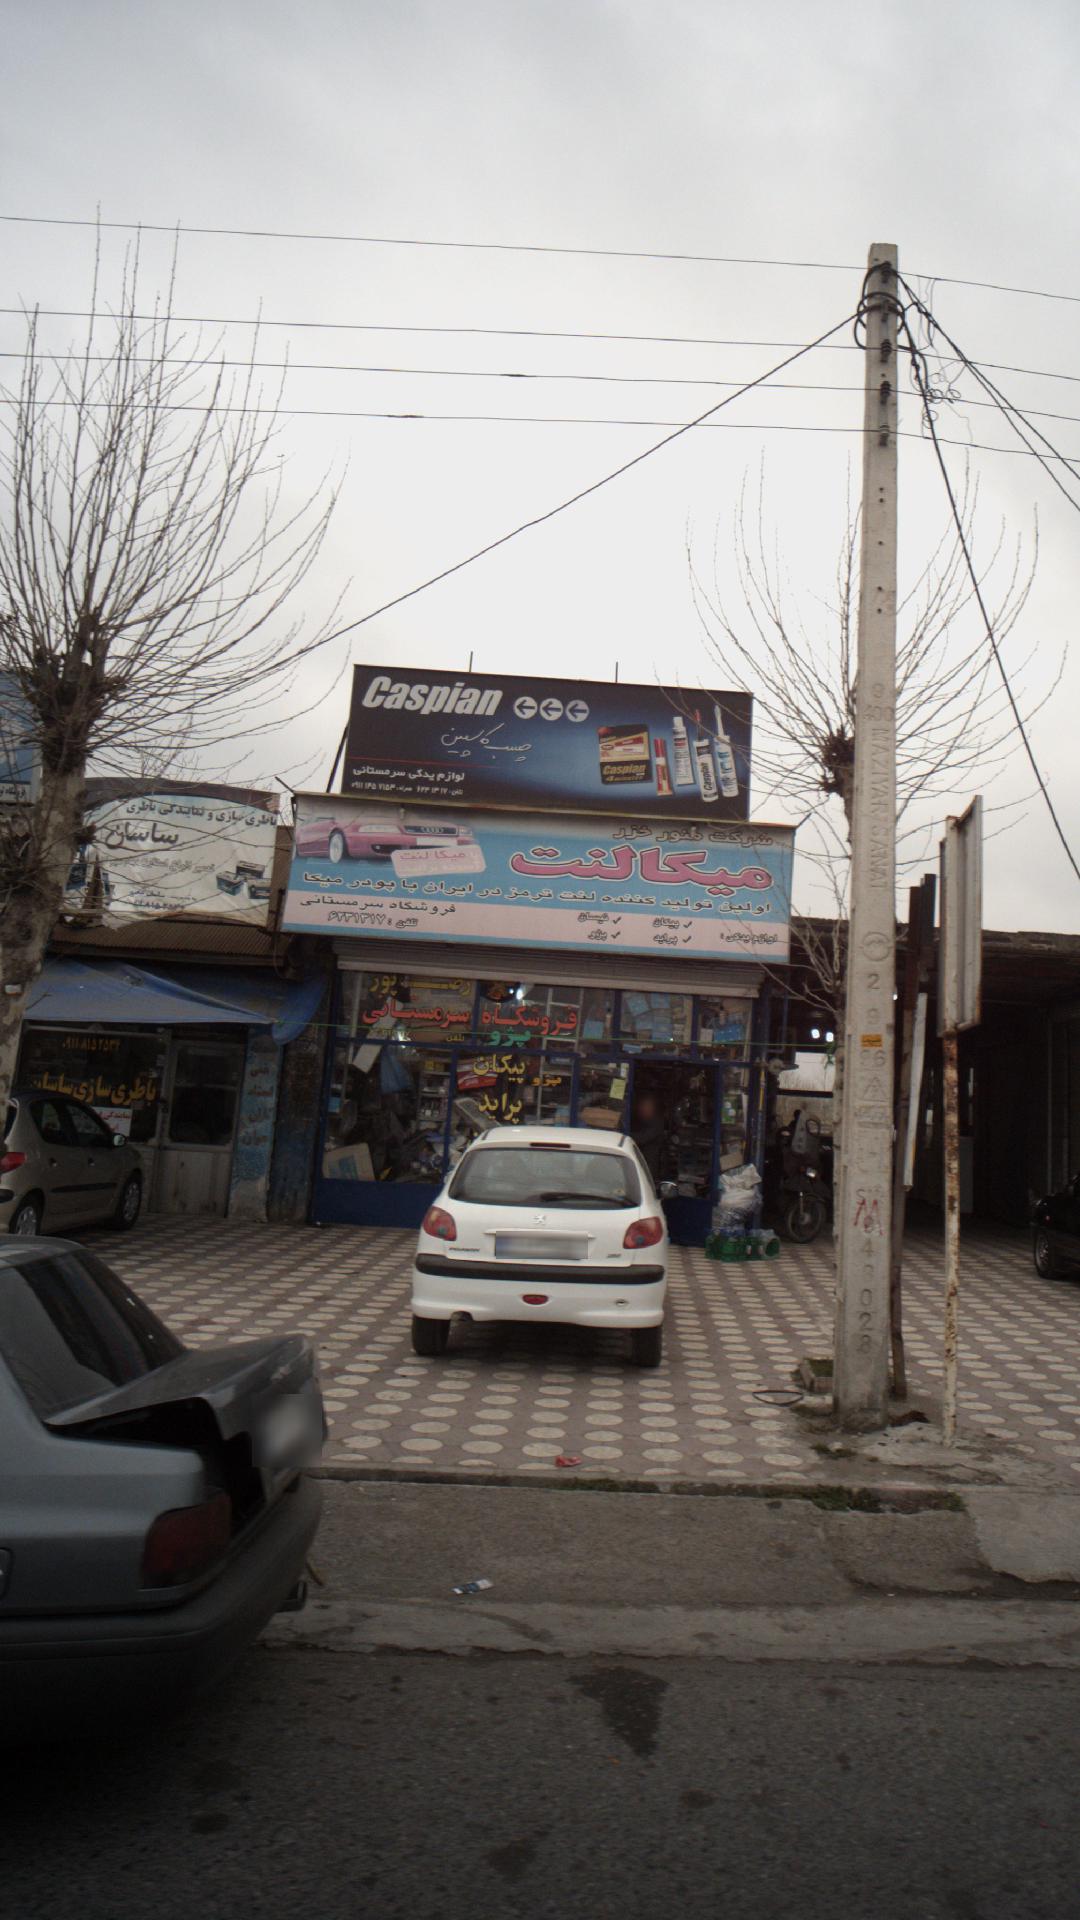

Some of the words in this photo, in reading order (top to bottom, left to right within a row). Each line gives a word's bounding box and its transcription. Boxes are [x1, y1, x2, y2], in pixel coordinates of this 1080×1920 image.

[362, 676, 503, 716] Caspian
[352, 765, 406, 778] سرمستانی
[408, 769, 436, 781] یدکی
[436, 772, 466, 783] لوازم
[611, 823, 652, 841] خزر
[709, 829, 773, 848] شرکت
[303, 872, 343, 887] میکا
[348, 878, 397, 893] پودر
[401, 878, 418, 892] با
[422, 882, 474, 896] ایران
[476, 886, 503, 899] در
[506, 887, 554, 901] ترمز
[558, 890, 596, 901] لنت
[299, 894, 384, 911] سرمستانی
[600, 893, 656, 906] کننده
[661, 898, 713, 912] تولید
[388, 900, 457, 916] فروشگاه
[717, 902, 771, 916] اولین
[362, 999, 471, 1028] سرمستانی
[480, 1003, 578, 1036] فروشگاه
[473, 1054, 526, 1084] پیکان
[478, 1092, 523, 1125] پراید
